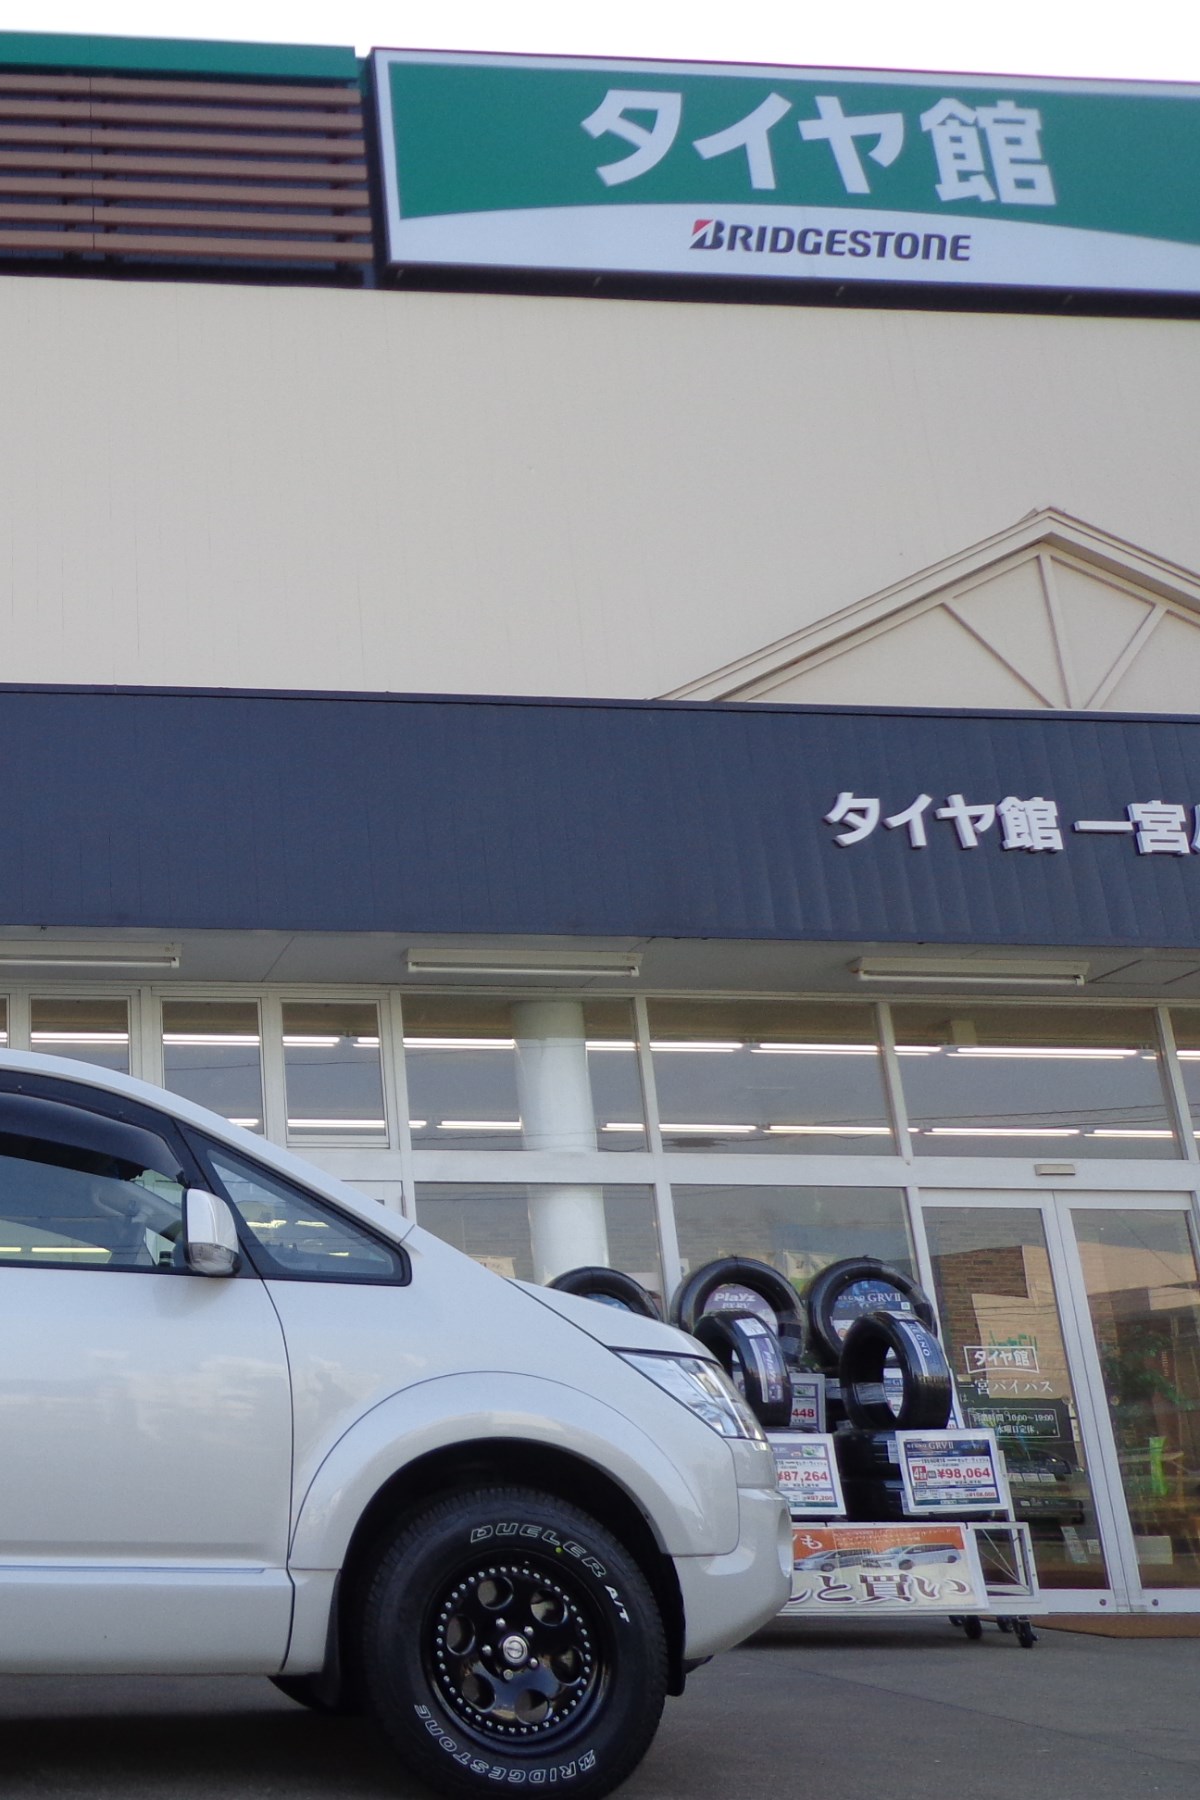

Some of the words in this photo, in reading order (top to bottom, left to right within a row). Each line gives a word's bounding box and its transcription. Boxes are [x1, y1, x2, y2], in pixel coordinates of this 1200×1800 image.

[580, 89, 1056, 205] タイヤ館
[689, 219, 972, 262] BRIDGESTONE
[823, 792, 1064, 853] タイヤ館
[1073, 800, 1200, 856] 一宮
[908, 1322, 931, 1358] REGNO
[974, 1350, 1030, 1366] タイヤ館
[937, 1467, 991, 1480] ¥98,064
[471, 1523, 606, 1578] DUELER
[414, 1703, 597, 1784] BRIDGESTONE
